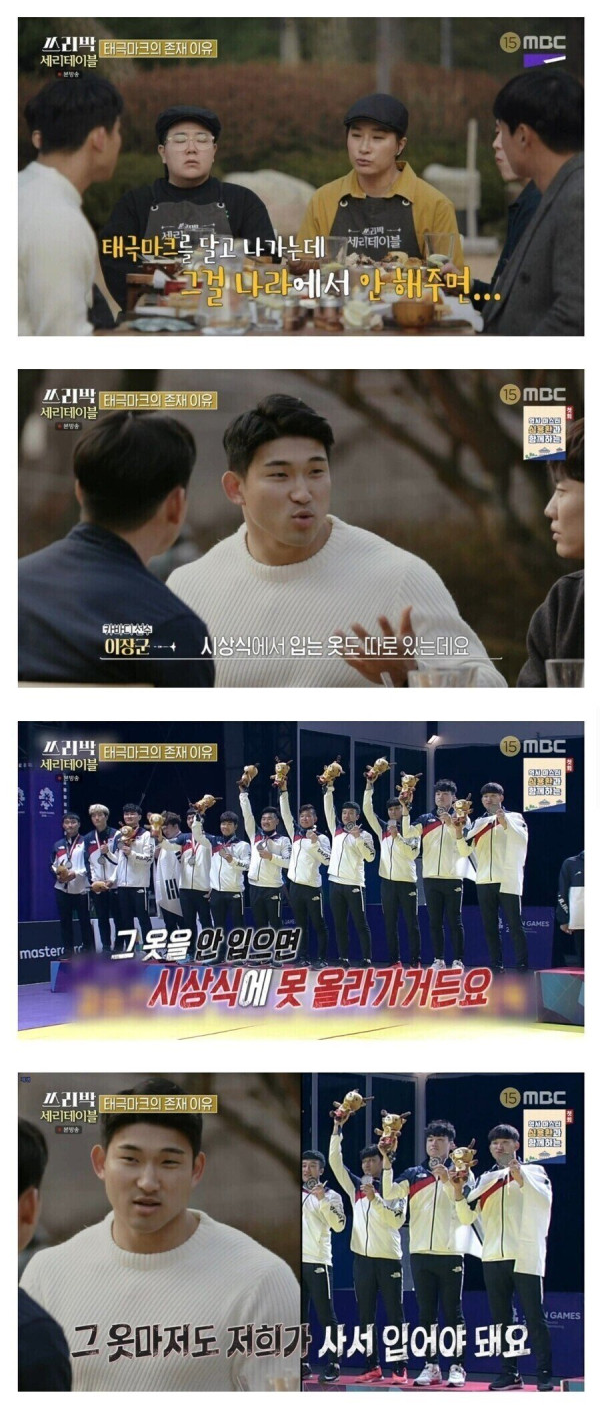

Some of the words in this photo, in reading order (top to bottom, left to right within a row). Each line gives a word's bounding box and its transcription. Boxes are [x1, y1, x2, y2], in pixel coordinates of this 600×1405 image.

[347, 234, 402, 249] 세리테이블
[526, 920, 550, 928] GAMES
[550, 1311, 581, 1320] GAMES
